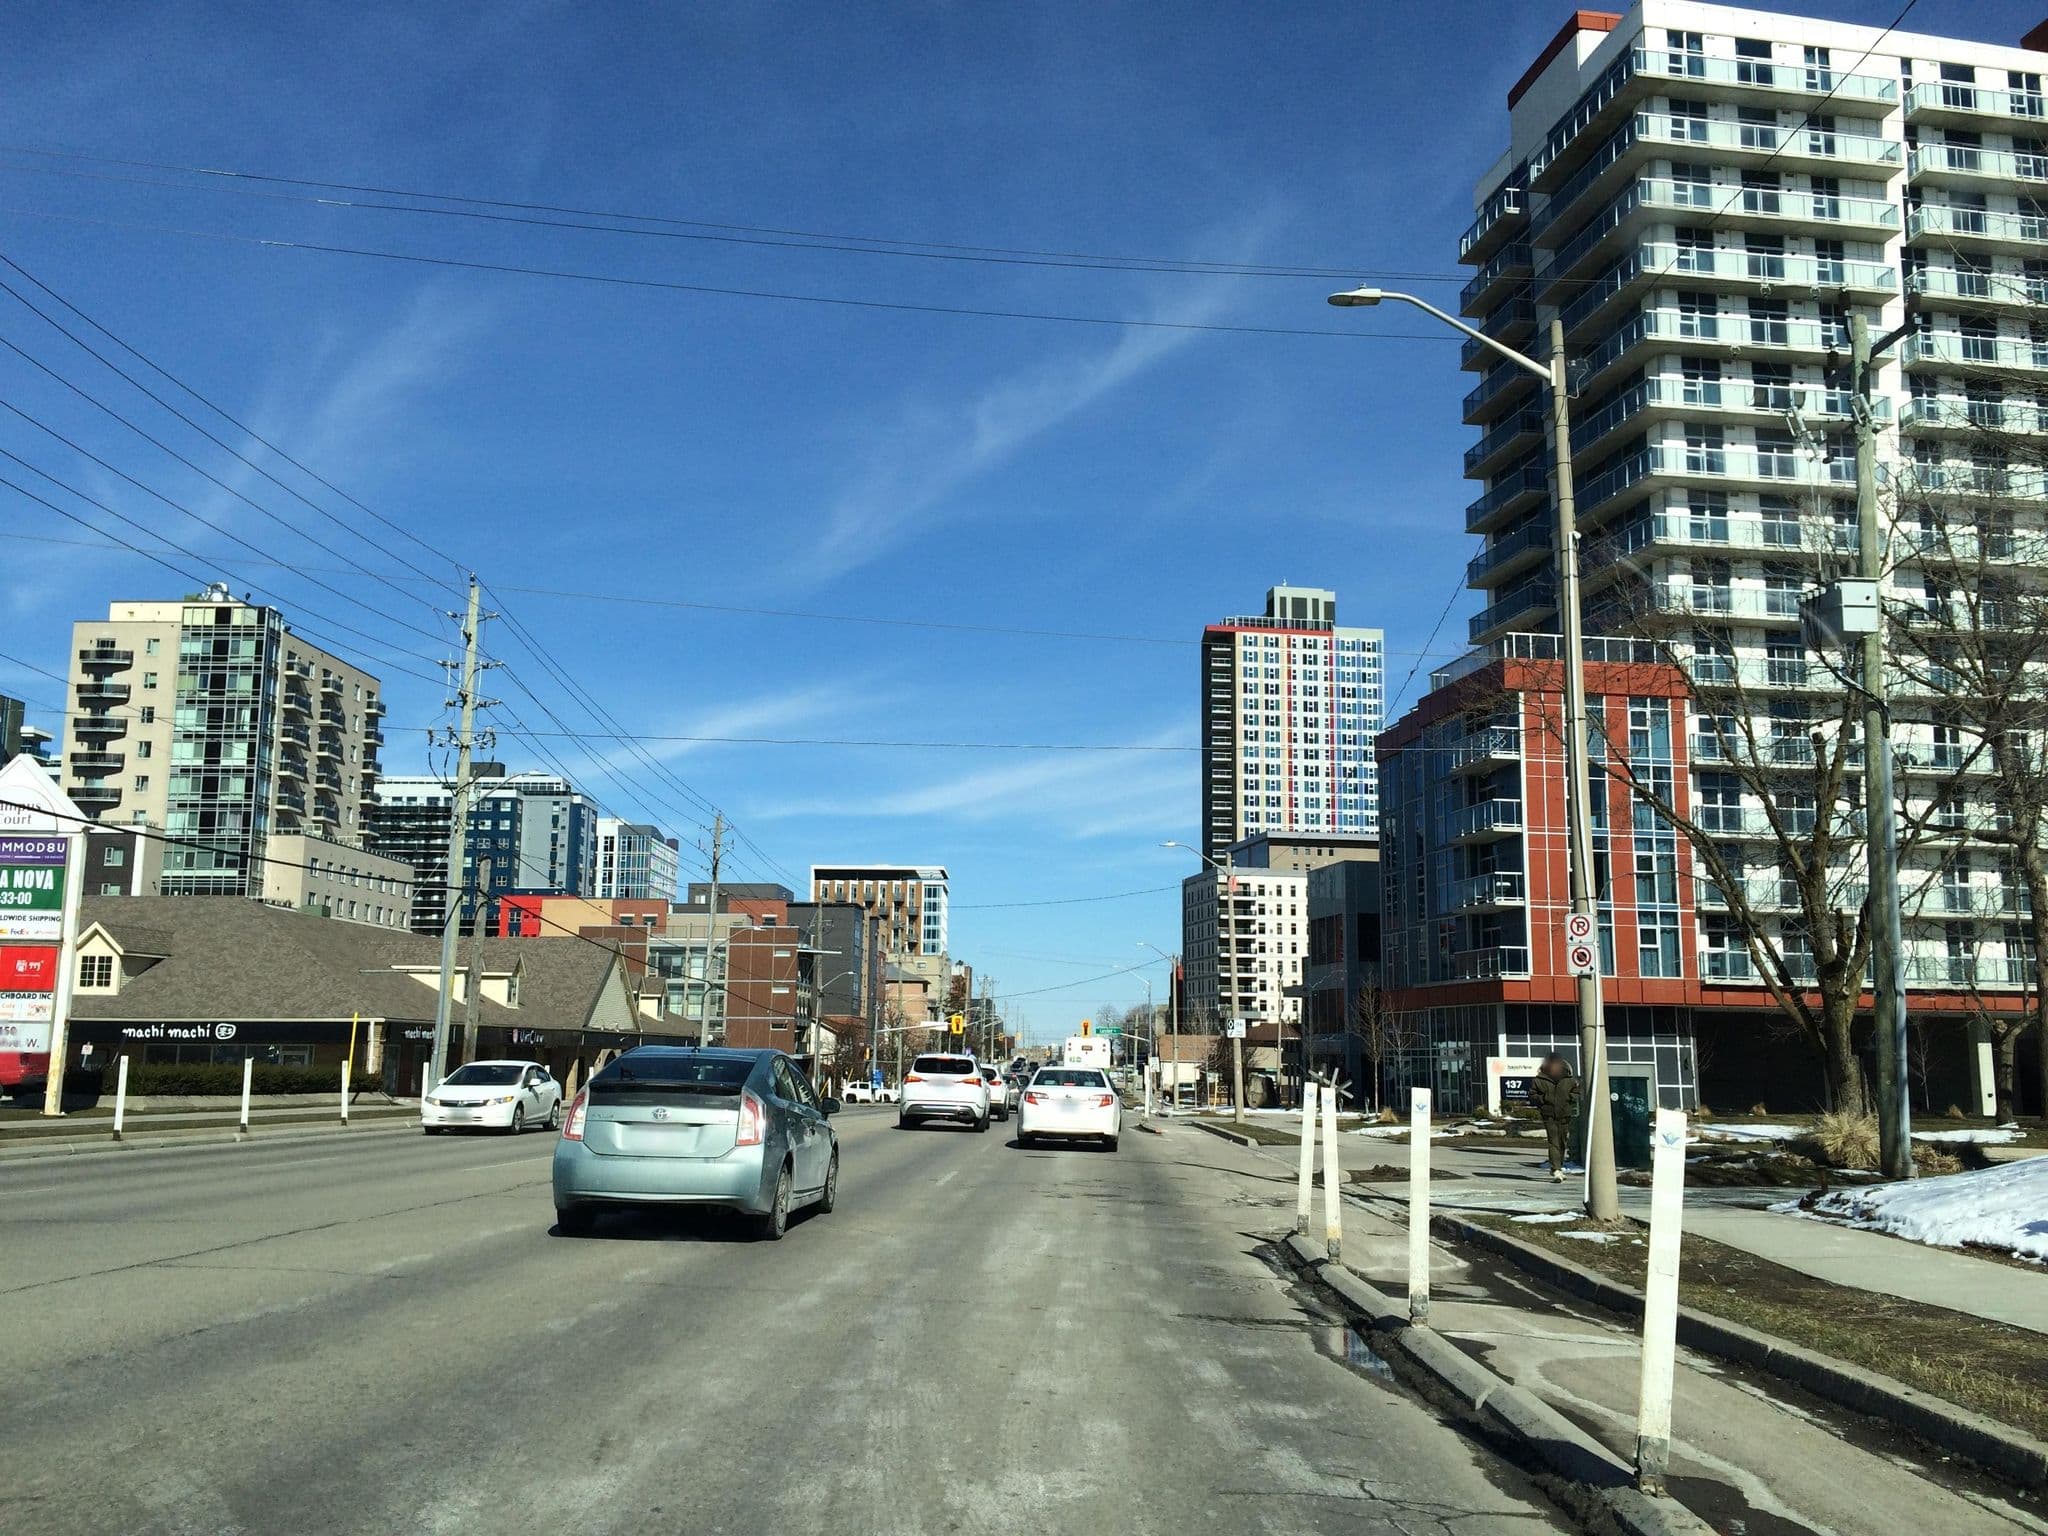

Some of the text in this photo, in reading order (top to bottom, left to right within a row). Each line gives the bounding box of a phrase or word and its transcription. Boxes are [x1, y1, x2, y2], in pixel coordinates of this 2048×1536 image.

[0, 802, 41, 815] mpus
[0, 814, 32, 825] ourt
[0, 842, 66, 853] MMOD8U
[13, 869, 54, 890] NOVA
[122, 1024, 165, 1038] machi
[168, 1024, 211, 1038] machi
[1505, 1080, 1522, 1089] 137
